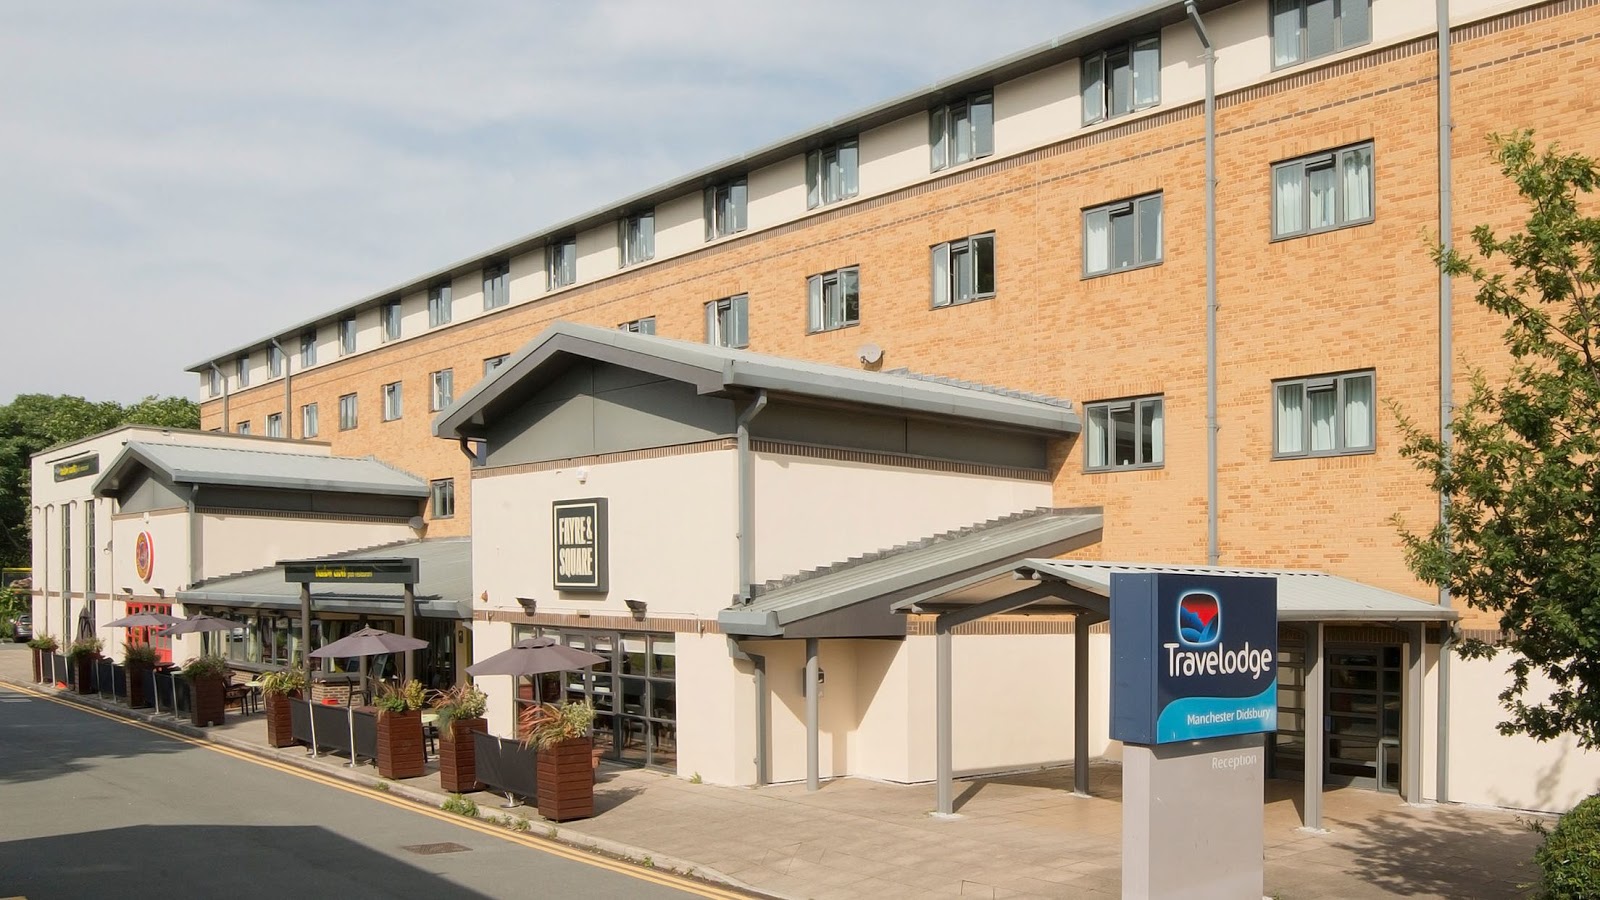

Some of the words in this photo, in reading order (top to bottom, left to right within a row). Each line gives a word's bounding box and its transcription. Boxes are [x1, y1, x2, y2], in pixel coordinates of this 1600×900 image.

[559, 517, 586, 545] FAYRE
[586, 516, 593, 544] &
[559, 547, 593, 578] SQUARE
[1163, 641, 1273, 680] Travelodge
[1187, 710, 1235, 726] Manchester
[1236, 706, 1271, 721] Didsbury
[1212, 754, 1257, 770] Reception
